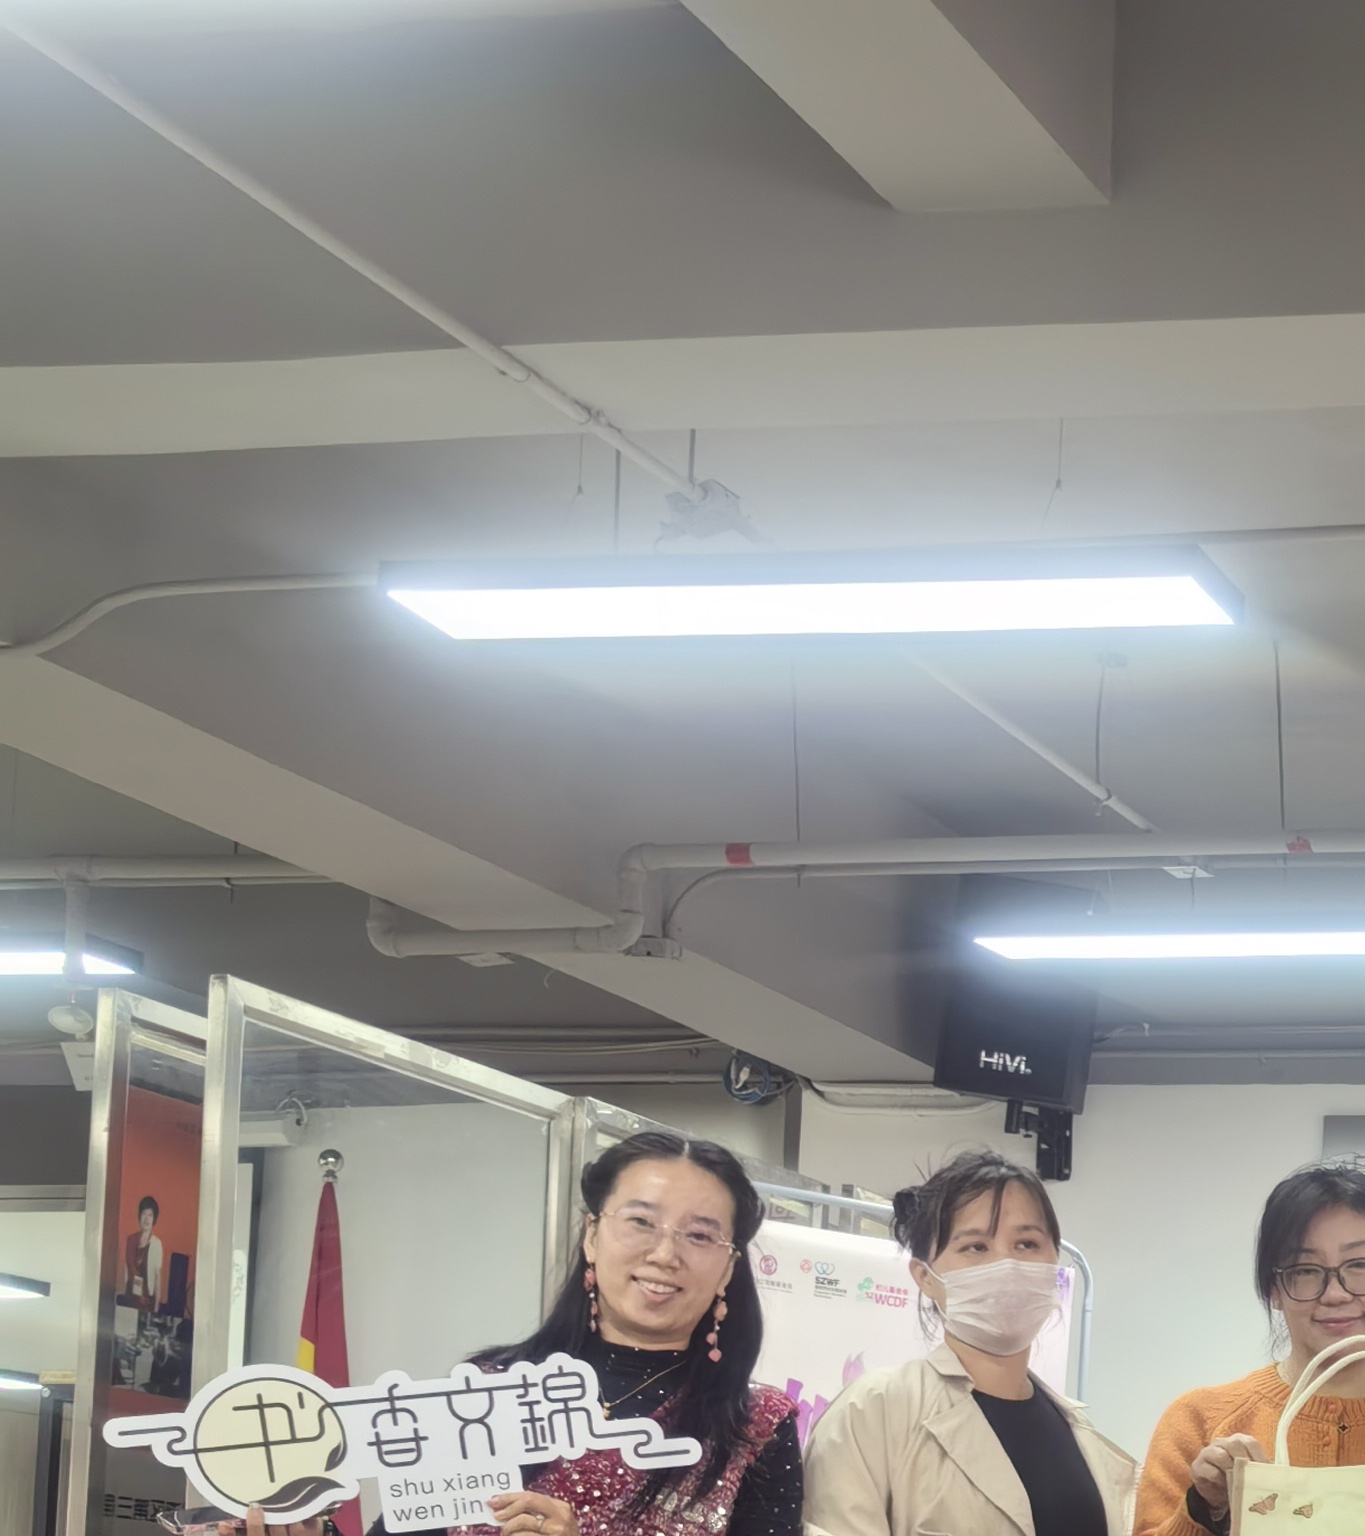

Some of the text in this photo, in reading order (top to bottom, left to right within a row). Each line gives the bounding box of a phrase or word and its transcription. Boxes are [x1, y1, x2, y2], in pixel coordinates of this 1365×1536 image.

[980, 1050, 1027, 1075] HiVi
[389, 1470, 512, 1500] shu xiang
[393, 1501, 446, 1521] wen
